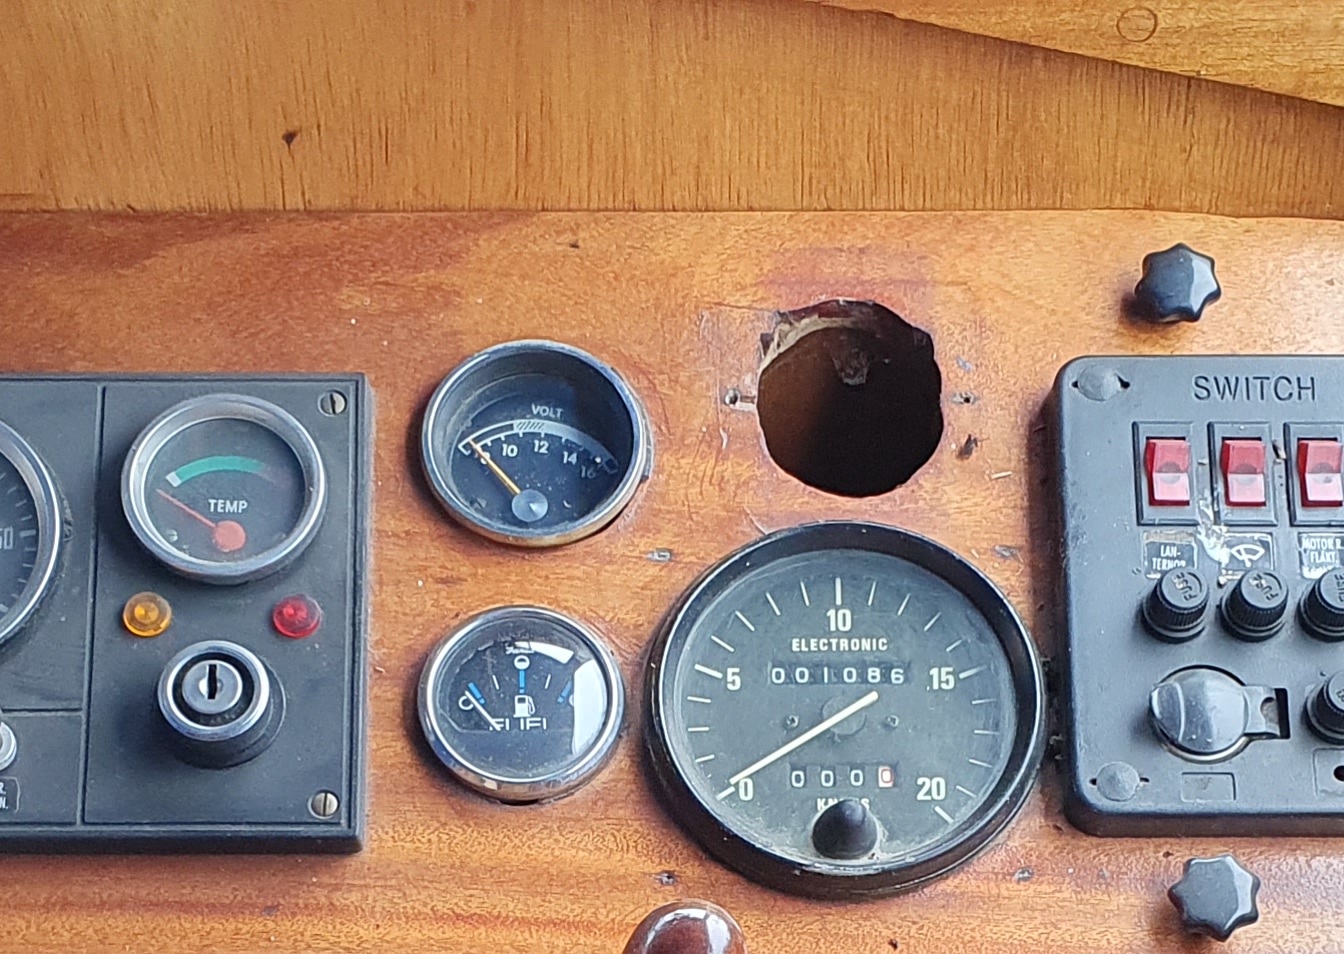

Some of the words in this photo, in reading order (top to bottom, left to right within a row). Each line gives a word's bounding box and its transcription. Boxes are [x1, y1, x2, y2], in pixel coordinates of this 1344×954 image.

[1193, 375, 1316, 402] SWITCH
[531, 403, 564, 419] VOLT
[502, 443, 518, 457] 10
[533, 440, 549, 454] 12
[562, 451, 578, 465] 14
[581, 466, 597, 479] 16
[208, 499, 249, 513] TEMP
[827, 609, 852, 632] 10
[792, 638, 888, 652] ELECTRONIC
[726, 667, 741, 691] 5
[772, 667, 904, 684] 001086
[929, 667, 955, 690] 15
[738, 778, 754, 801] 0
[917, 777, 946, 801] 20
